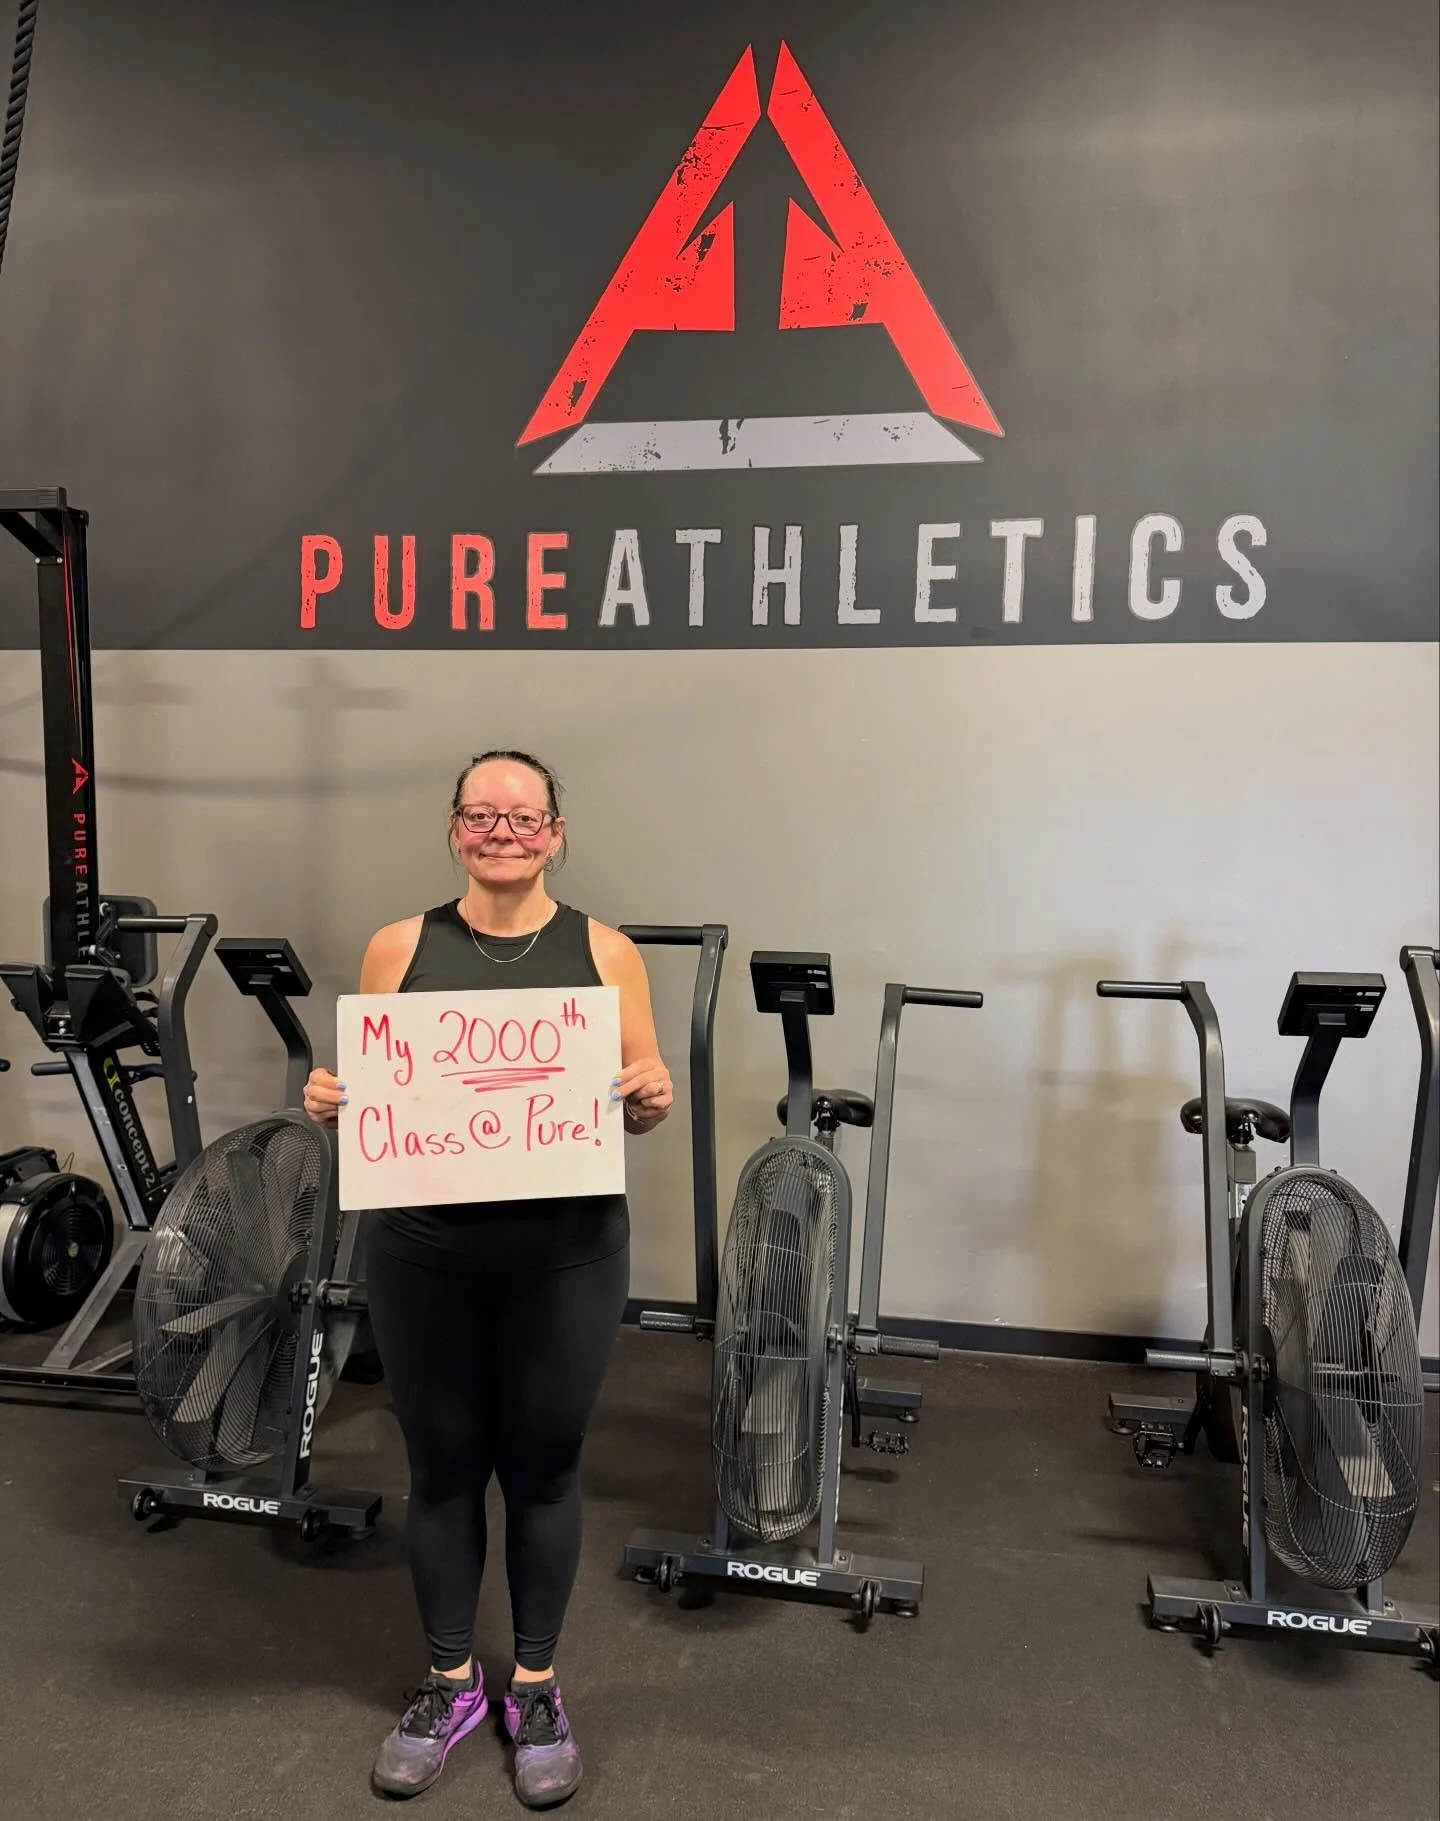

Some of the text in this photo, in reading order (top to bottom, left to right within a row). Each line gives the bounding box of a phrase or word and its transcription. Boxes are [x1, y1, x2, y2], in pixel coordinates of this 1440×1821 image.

[73, 813, 91, 965] PUREATHLE
[361, 998, 586, 1086] My 2000th
[359, 1104, 465, 1162] Class
[526, 1094, 602, 1151] Pure!
[300, 1331, 323, 1458] ROGUE
[203, 1493, 280, 1514] ROGUE
[727, 1561, 820, 1586] ROGUE
[1267, 1610, 1372, 1635] ROGUE
